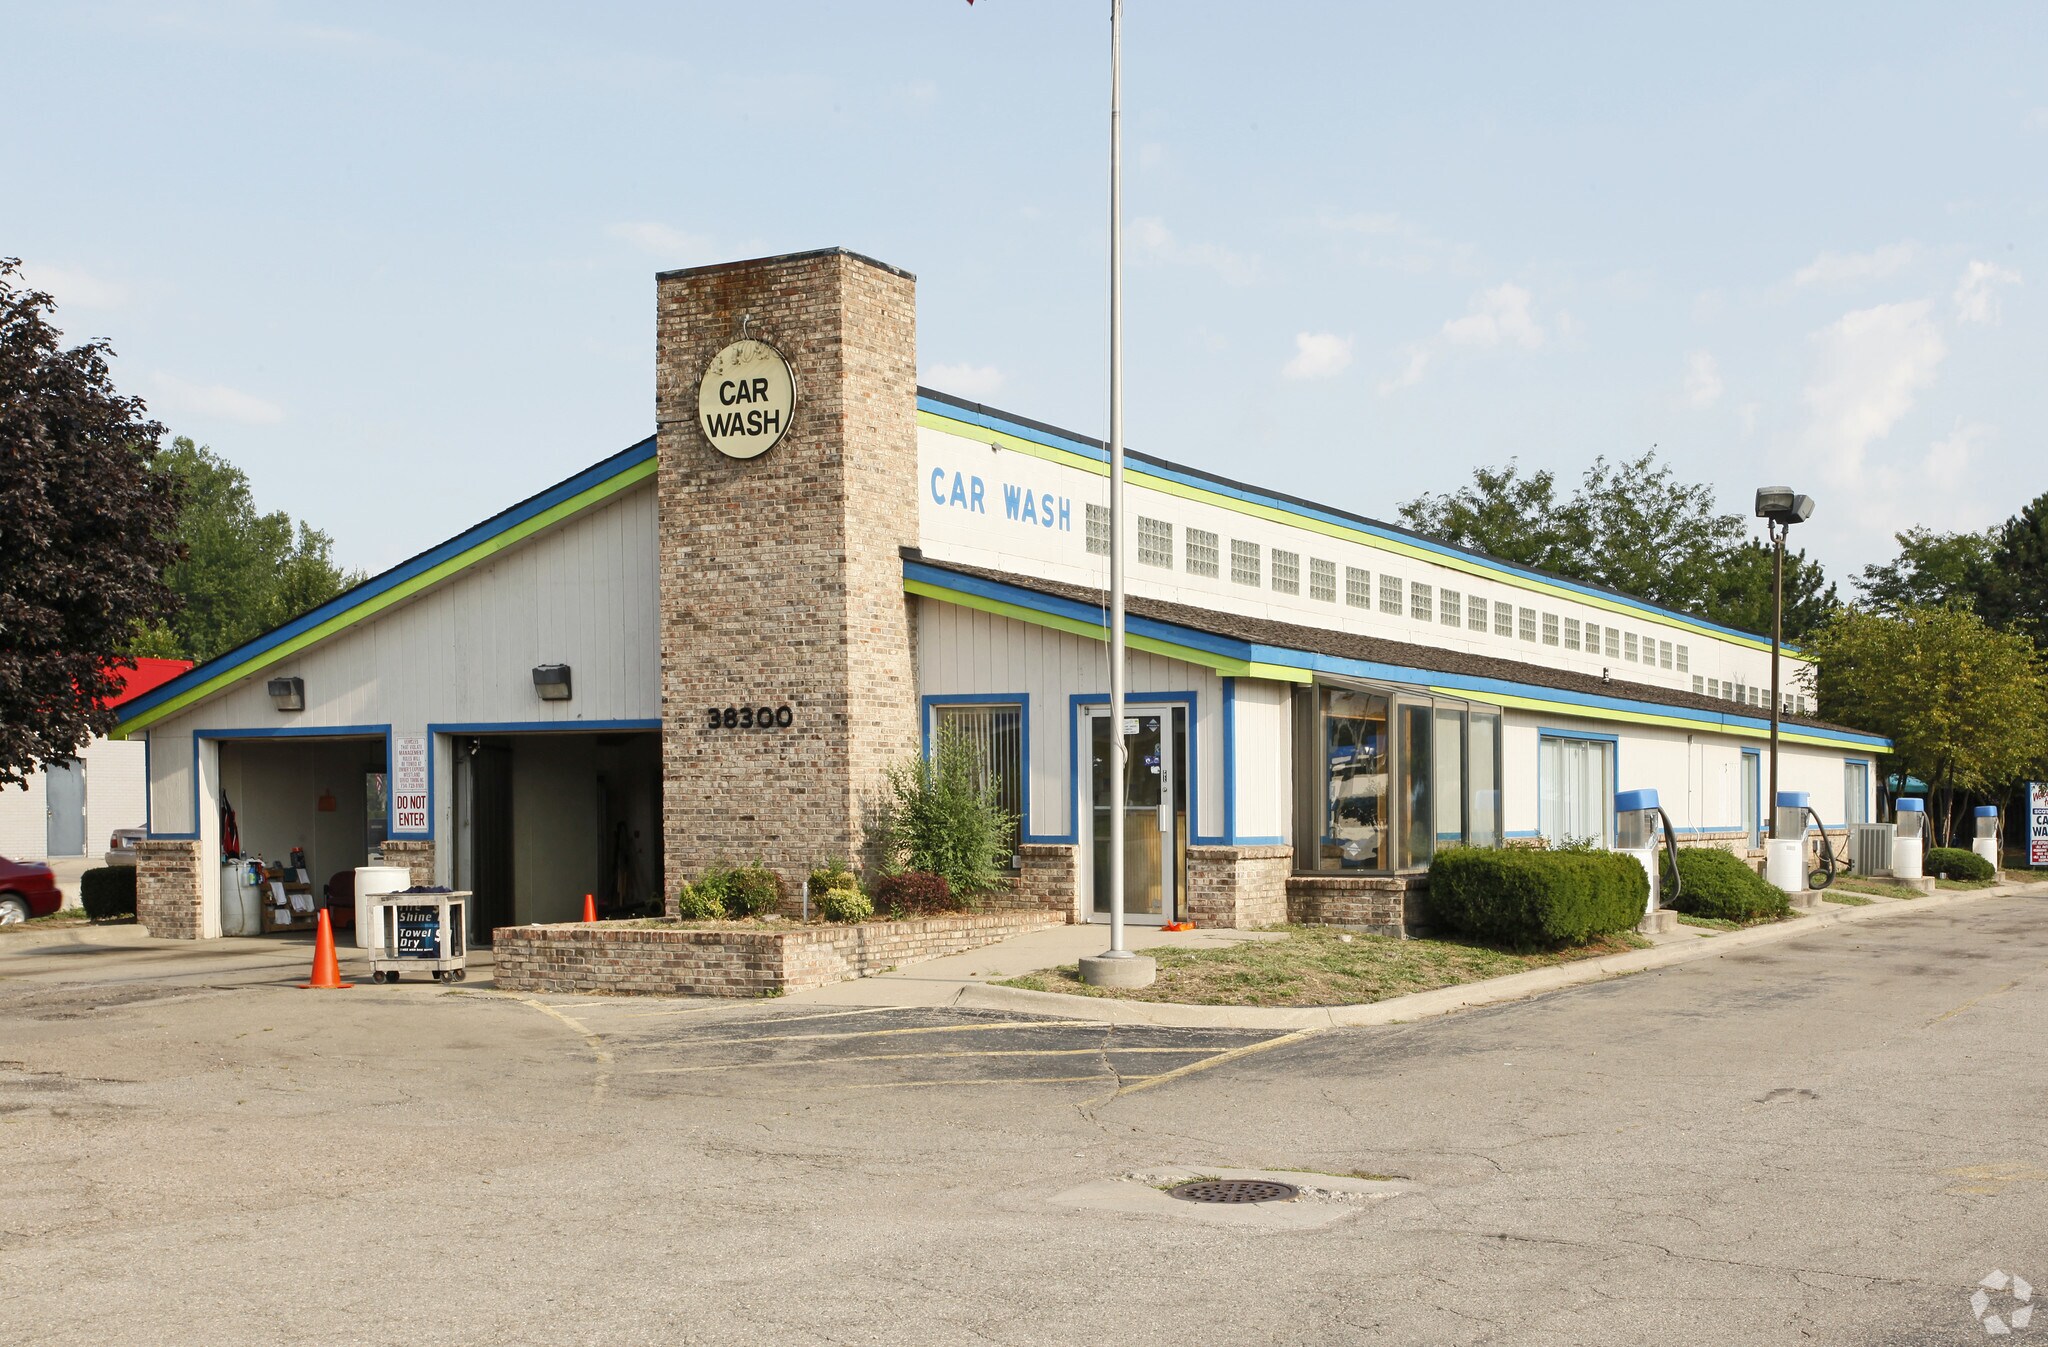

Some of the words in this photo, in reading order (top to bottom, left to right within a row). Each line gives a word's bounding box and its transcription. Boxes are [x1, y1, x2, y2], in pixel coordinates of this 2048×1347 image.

[719, 377, 769, 406] CAR
[706, 409, 780, 438] WASH
[931, 466, 985, 514] CAR
[1003, 483, 1071, 532] WASH
[708, 705, 793, 729] 38300
[397, 795, 408, 810] DO
[410, 795, 426, 810] NOT
[398, 812, 425, 827] ENTER
[400, 912, 432, 922] Shine
[400, 928, 432, 938] Towel
[400, 938, 420, 949] Dry
